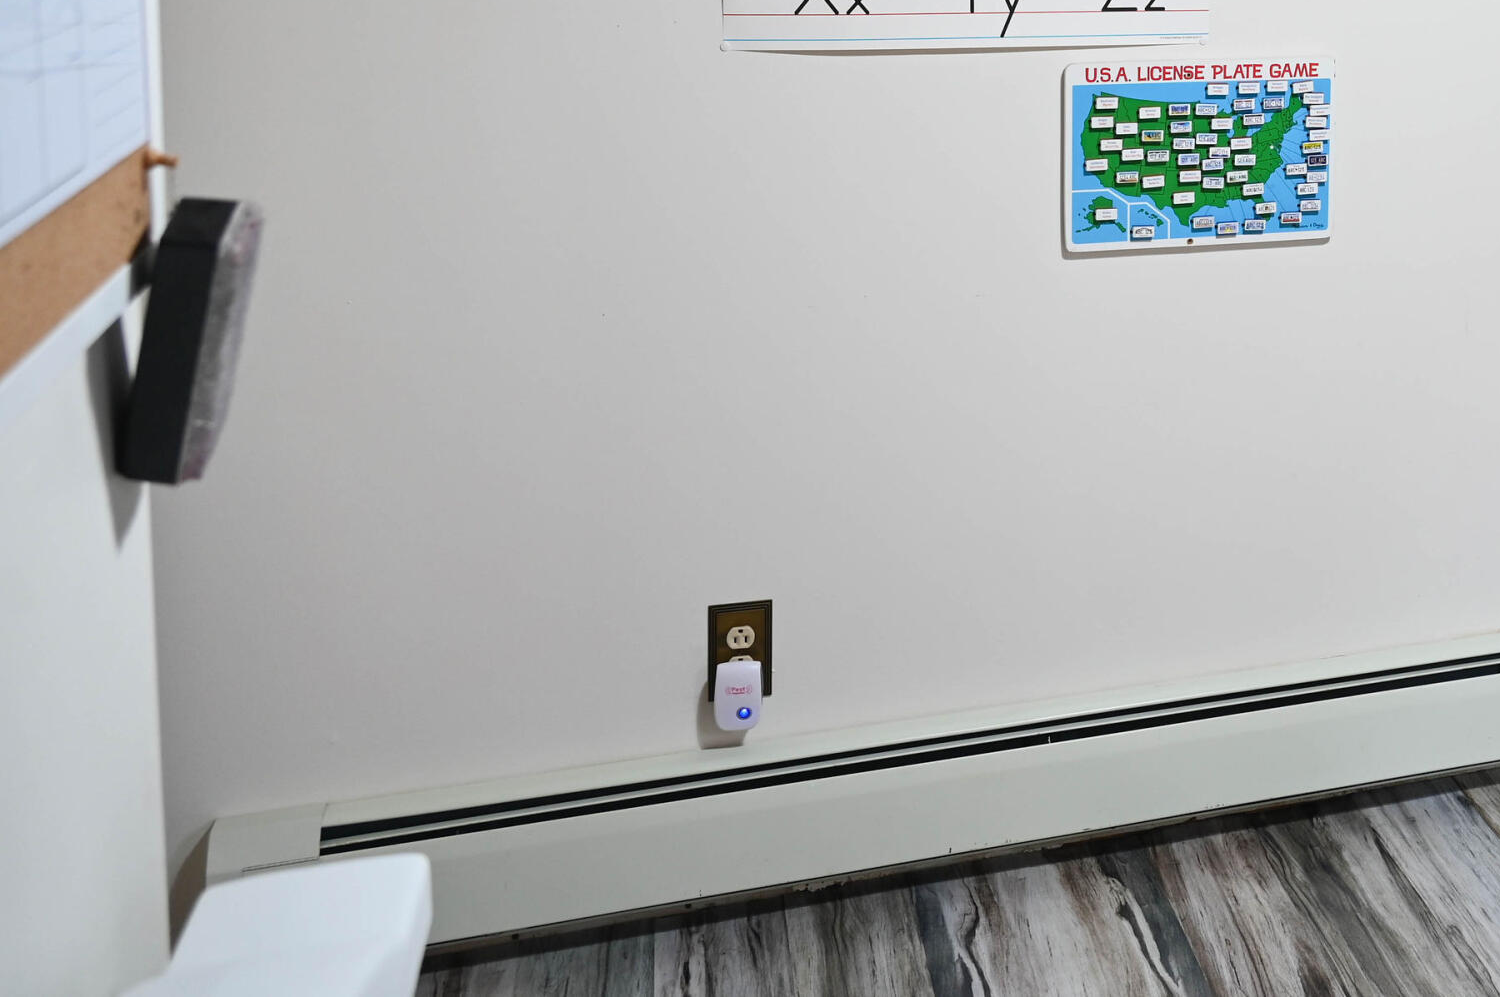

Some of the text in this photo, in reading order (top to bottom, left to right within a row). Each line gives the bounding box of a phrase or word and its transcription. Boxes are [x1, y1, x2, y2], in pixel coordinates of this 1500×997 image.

[1085, 63, 1319, 82] U.S.A. LICENSE PLATE GAME
